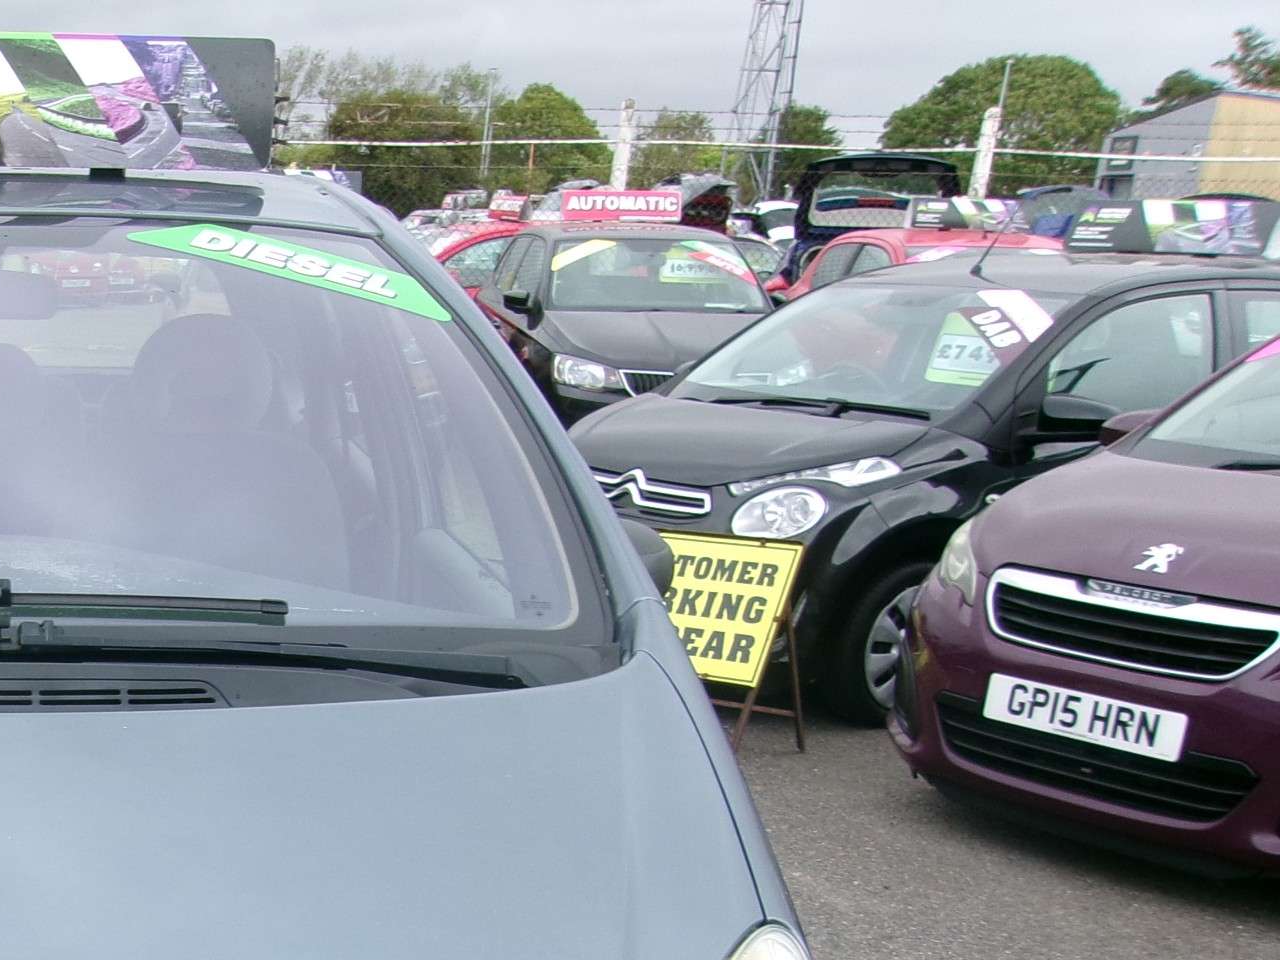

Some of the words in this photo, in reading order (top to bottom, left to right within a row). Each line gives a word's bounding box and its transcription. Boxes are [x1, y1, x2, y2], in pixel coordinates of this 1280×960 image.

[567, 195, 678, 211] AUTOMATIC
[189, 229, 398, 299] DIESEL
[970, 309, 1023, 348] DAB
[674, 554, 779, 587] TOMER
[1007, 683, 1082, 728] GP15
[1088, 700, 1161, 747] HRN
